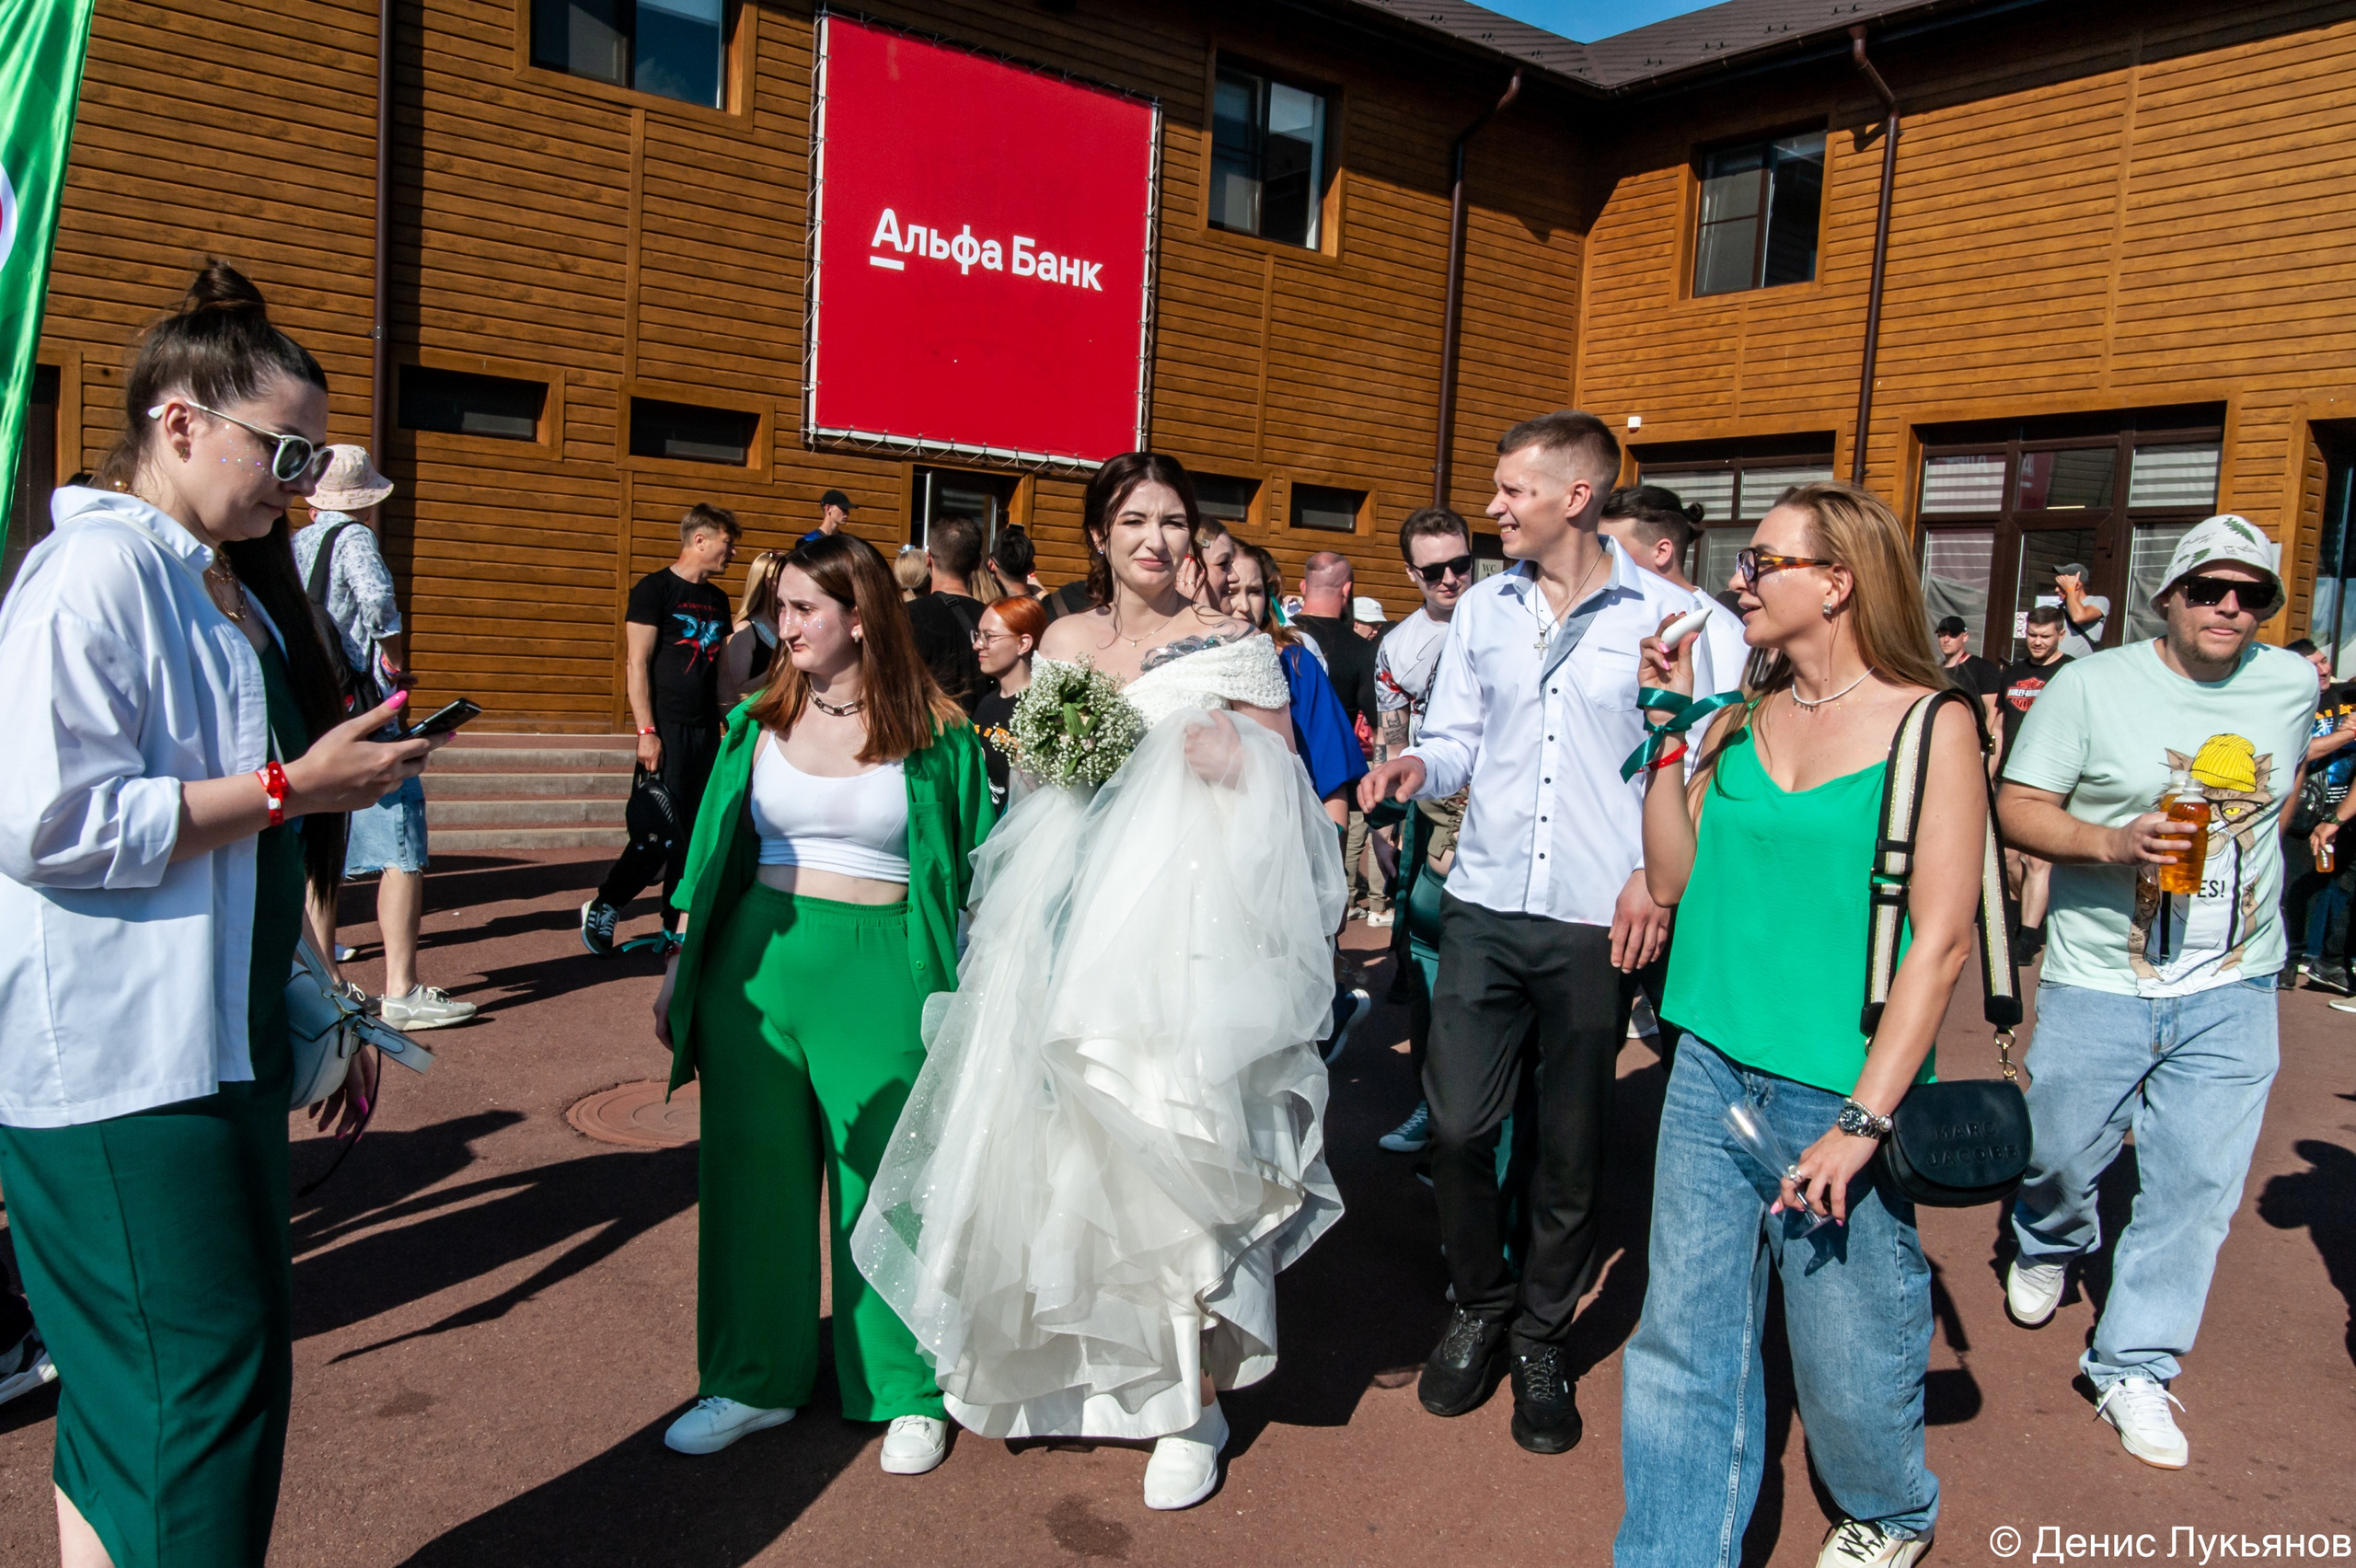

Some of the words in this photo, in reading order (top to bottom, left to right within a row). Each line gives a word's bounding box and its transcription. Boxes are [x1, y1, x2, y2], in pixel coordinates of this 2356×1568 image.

[870, 208, 1003, 275] Альфа
[1012, 235, 1103, 291] Банк
[1482, 563, 1496, 573] WC
[2187, 880, 2225, 898] ES!
[1934, 1121, 1998, 1140] MARC
[1927, 1144, 2019, 1167] JACOBS
